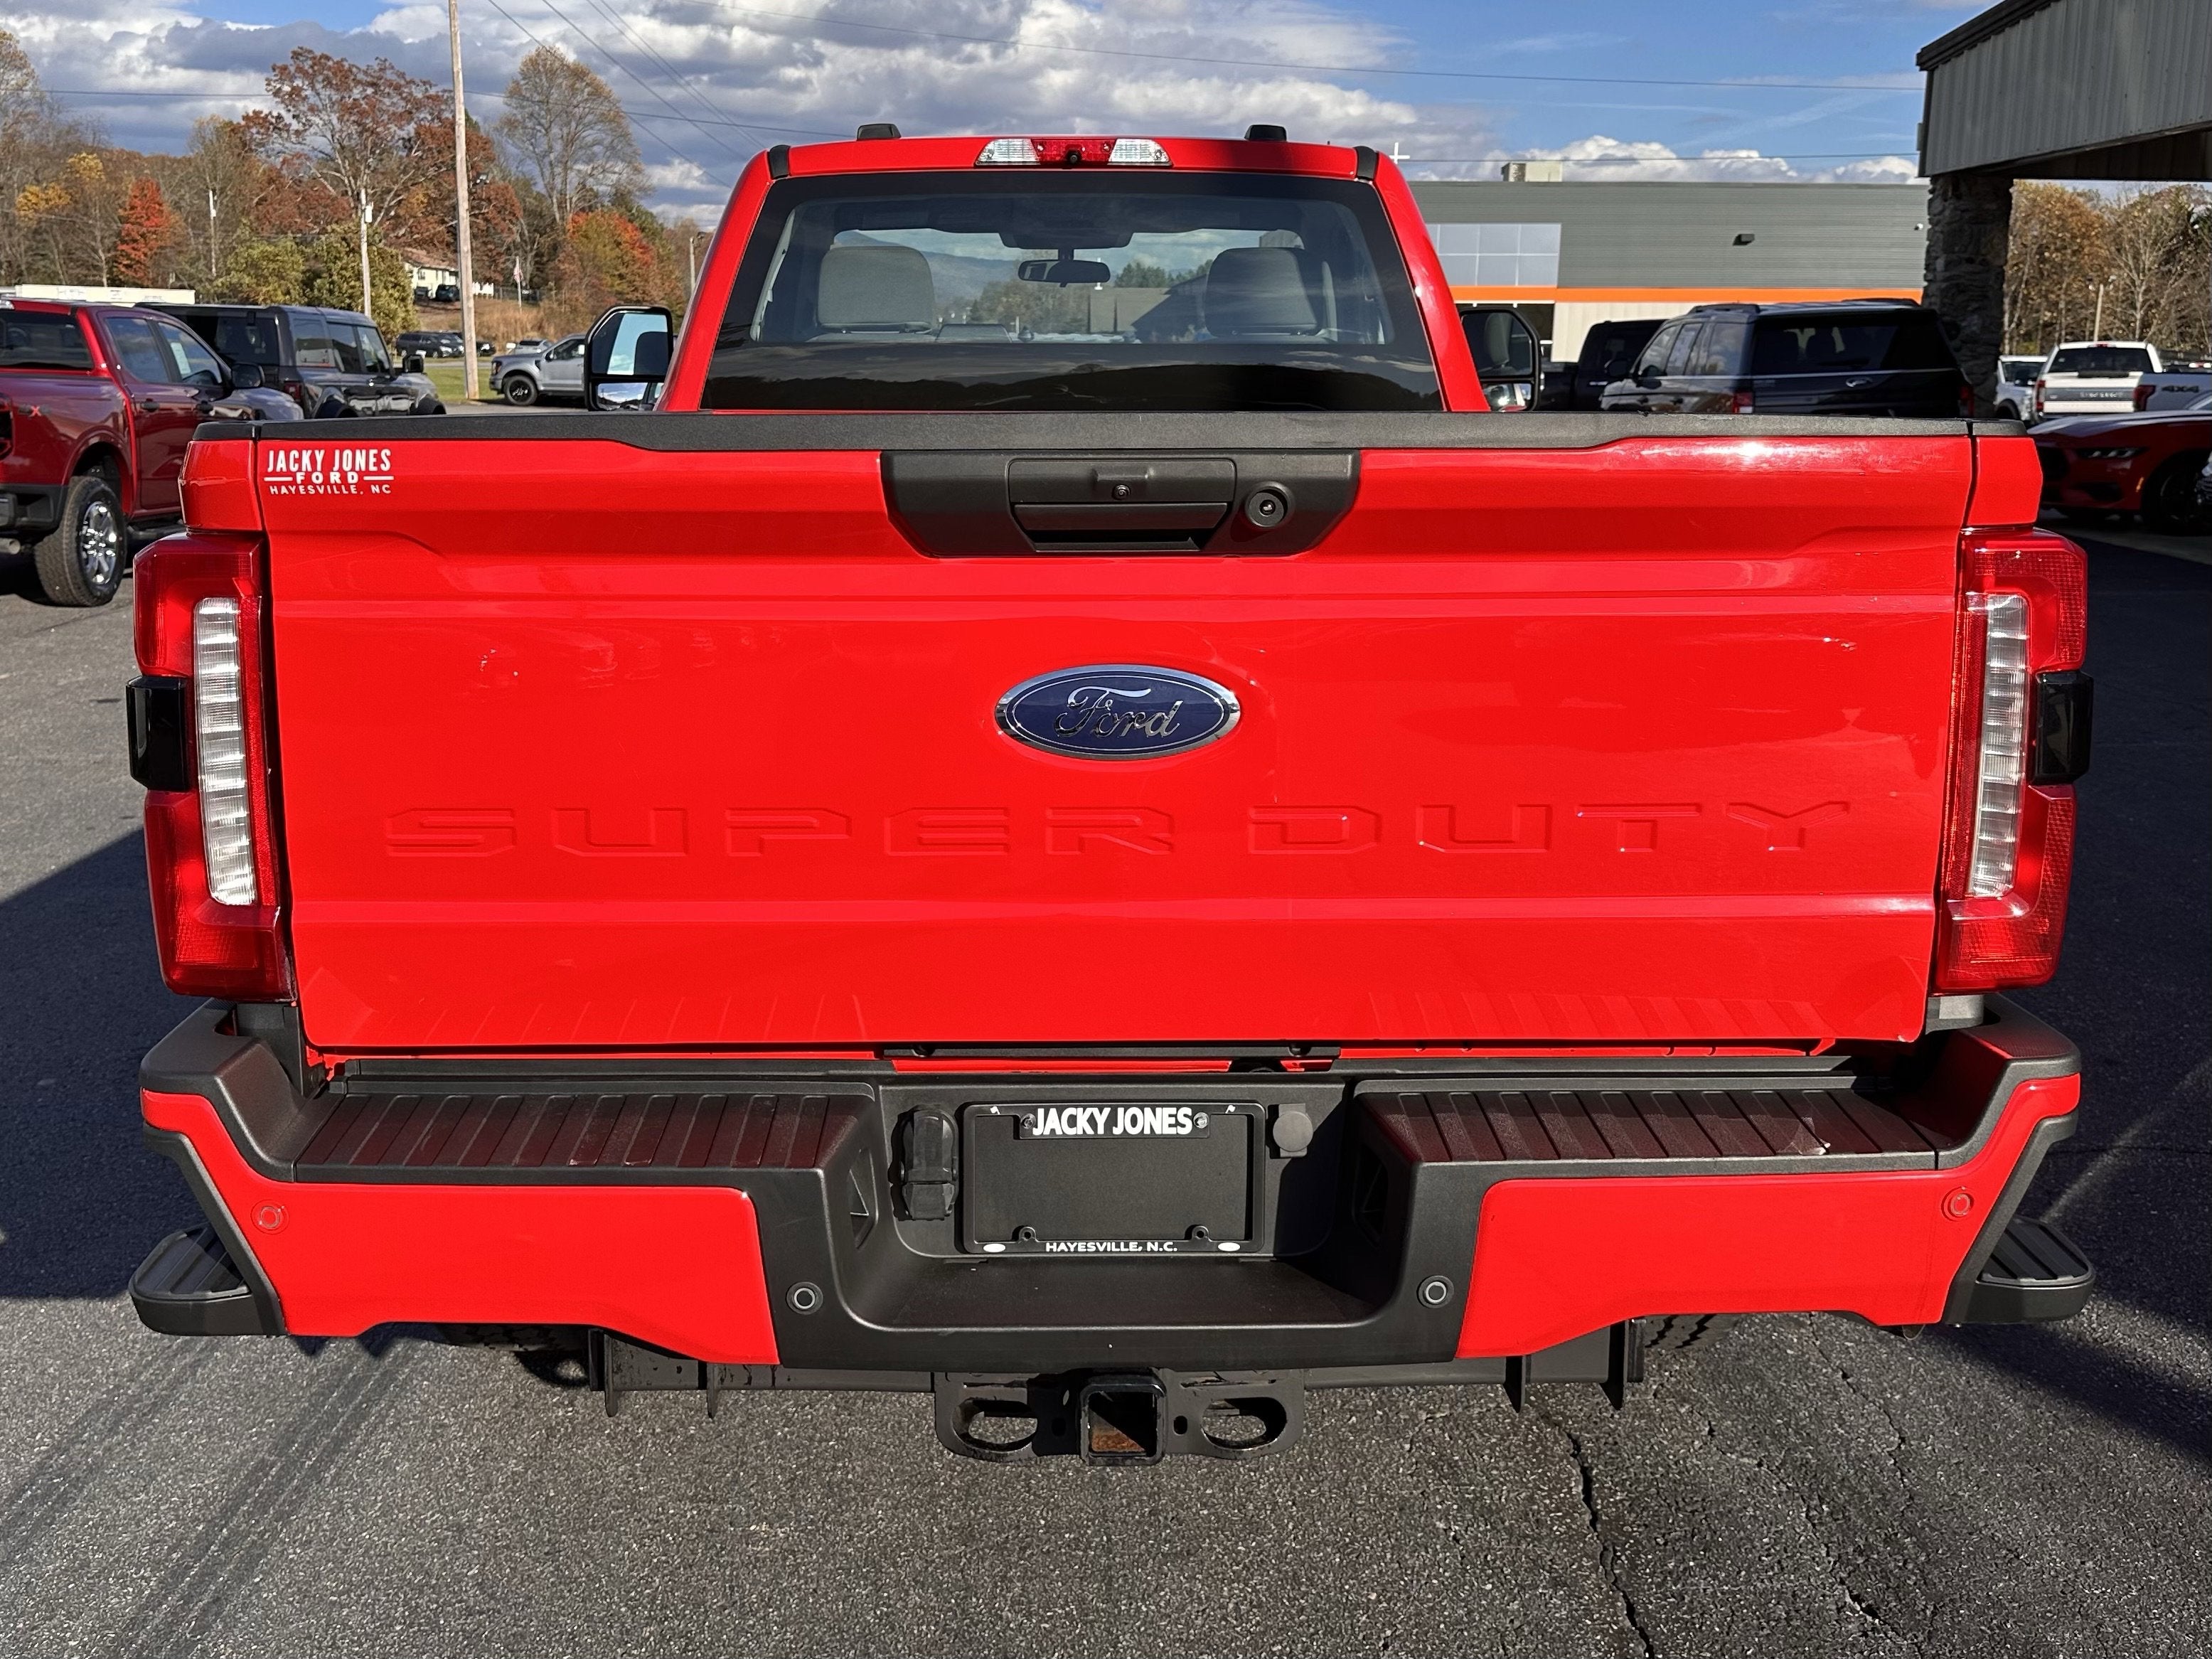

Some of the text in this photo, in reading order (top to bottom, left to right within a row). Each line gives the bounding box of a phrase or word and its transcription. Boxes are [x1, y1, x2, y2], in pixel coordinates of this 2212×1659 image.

[267, 449, 392, 473] JACKY JONES
[295, 471, 360, 485] FORD
[370, 484, 392, 494] NC
[1053, 685, 1183, 738] Ford
[384, 801, 1851, 857] SUPER DUTY
[1032, 1106, 1193, 1136] JACKY JONES
[1045, 1241, 1178, 1253] HAYESVILLE, N.C.
